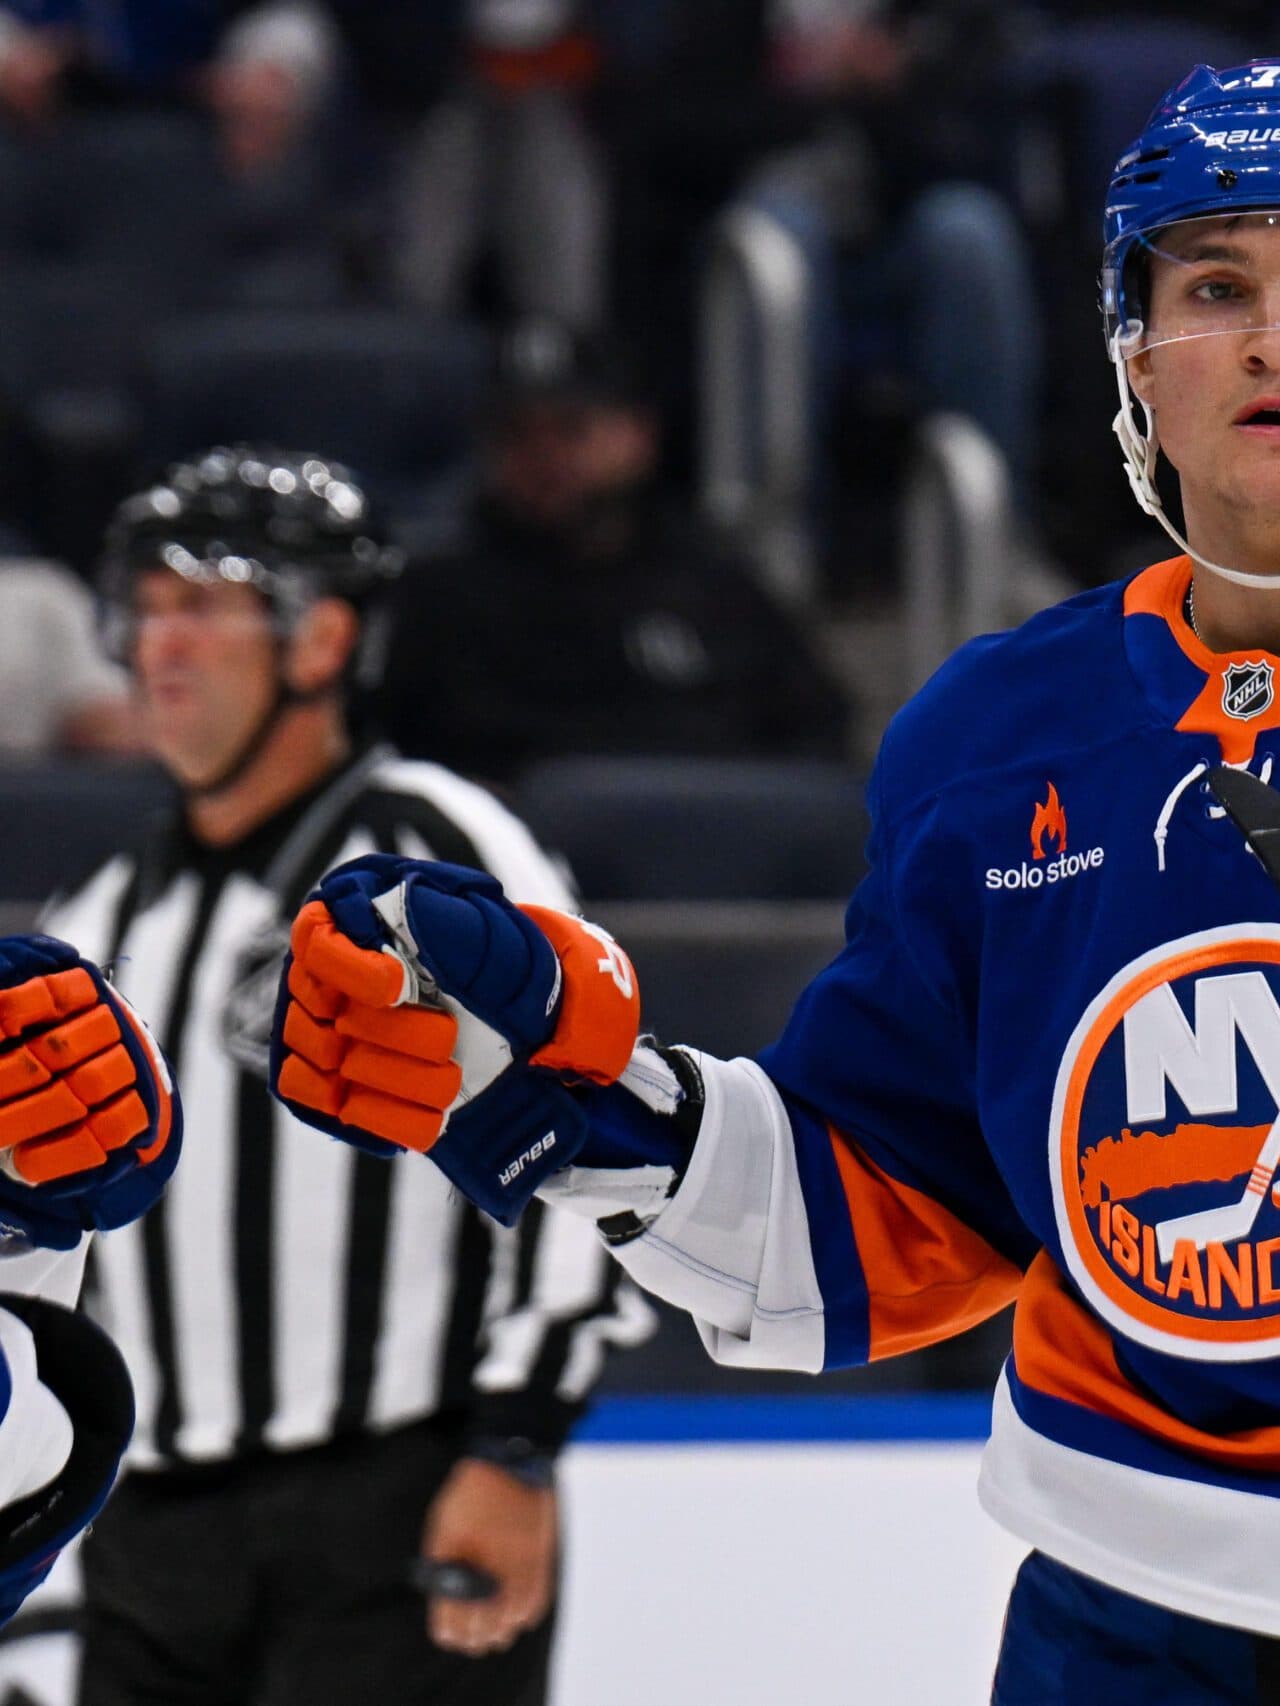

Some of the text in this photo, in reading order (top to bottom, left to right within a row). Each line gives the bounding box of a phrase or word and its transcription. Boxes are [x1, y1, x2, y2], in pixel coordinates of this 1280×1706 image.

[1251, 66, 1280, 87] 7
[1233, 676, 1265, 709] NHL
[985, 846, 1104, 888] solo stove
[498, 1130, 557, 1186] BAUER
